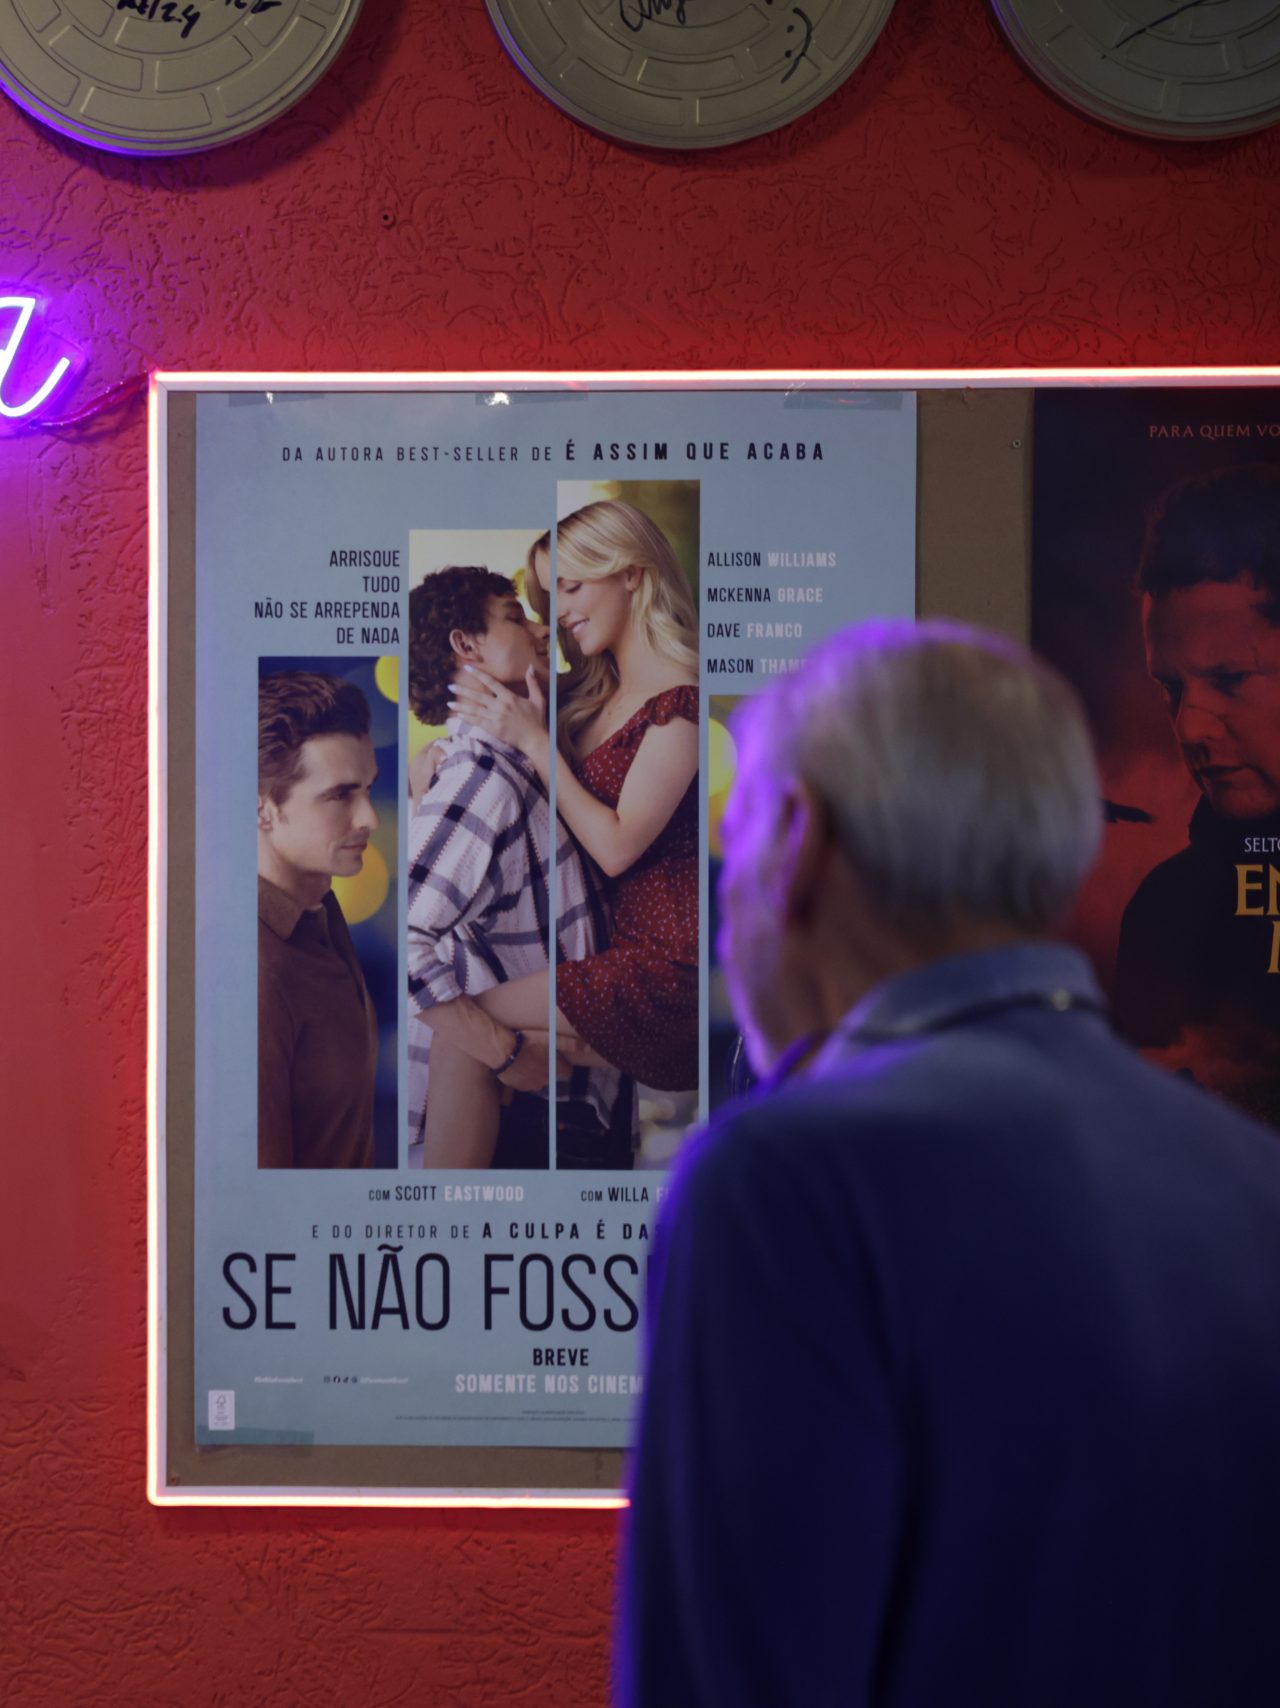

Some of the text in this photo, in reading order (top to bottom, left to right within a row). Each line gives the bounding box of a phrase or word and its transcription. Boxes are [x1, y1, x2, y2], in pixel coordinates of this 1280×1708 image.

[1149, 425, 1194, 438] PARA
[1199, 424, 1251, 440] QUEM
[282, 439, 824, 462] DA AUTORA BEST-SELLER DE É ASSIM QUE ACABA
[329, 550, 400, 568] ARRISQUE
[707, 552, 837, 568] ALLISON WILLIAMS
[362, 575, 400, 593] TUDO
[707, 587, 824, 603] MCKENNA GRACE
[254, 597, 400, 618] NÃO SE ARREPENDA
[337, 627, 400, 644] DE NADA
[707, 623, 803, 638] DAVE FRANCO
[707, 658, 807, 674] MASON THAM
[1244, 837, 1280, 853] SELT
[369, 1185, 524, 1202] COM SCOTT EASTWOOD
[581, 1190, 603, 1202] COM
[608, 1187, 649, 1202] WILLA
[312, 1219, 662, 1241] E DO DIRETOR DE A CULPA É DA
[222, 1243, 656, 1332] SE NÃO FOSS
[532, 1348, 590, 1367] BREVE
[455, 1374, 644, 1394] SOMENTE NOS CINEM
